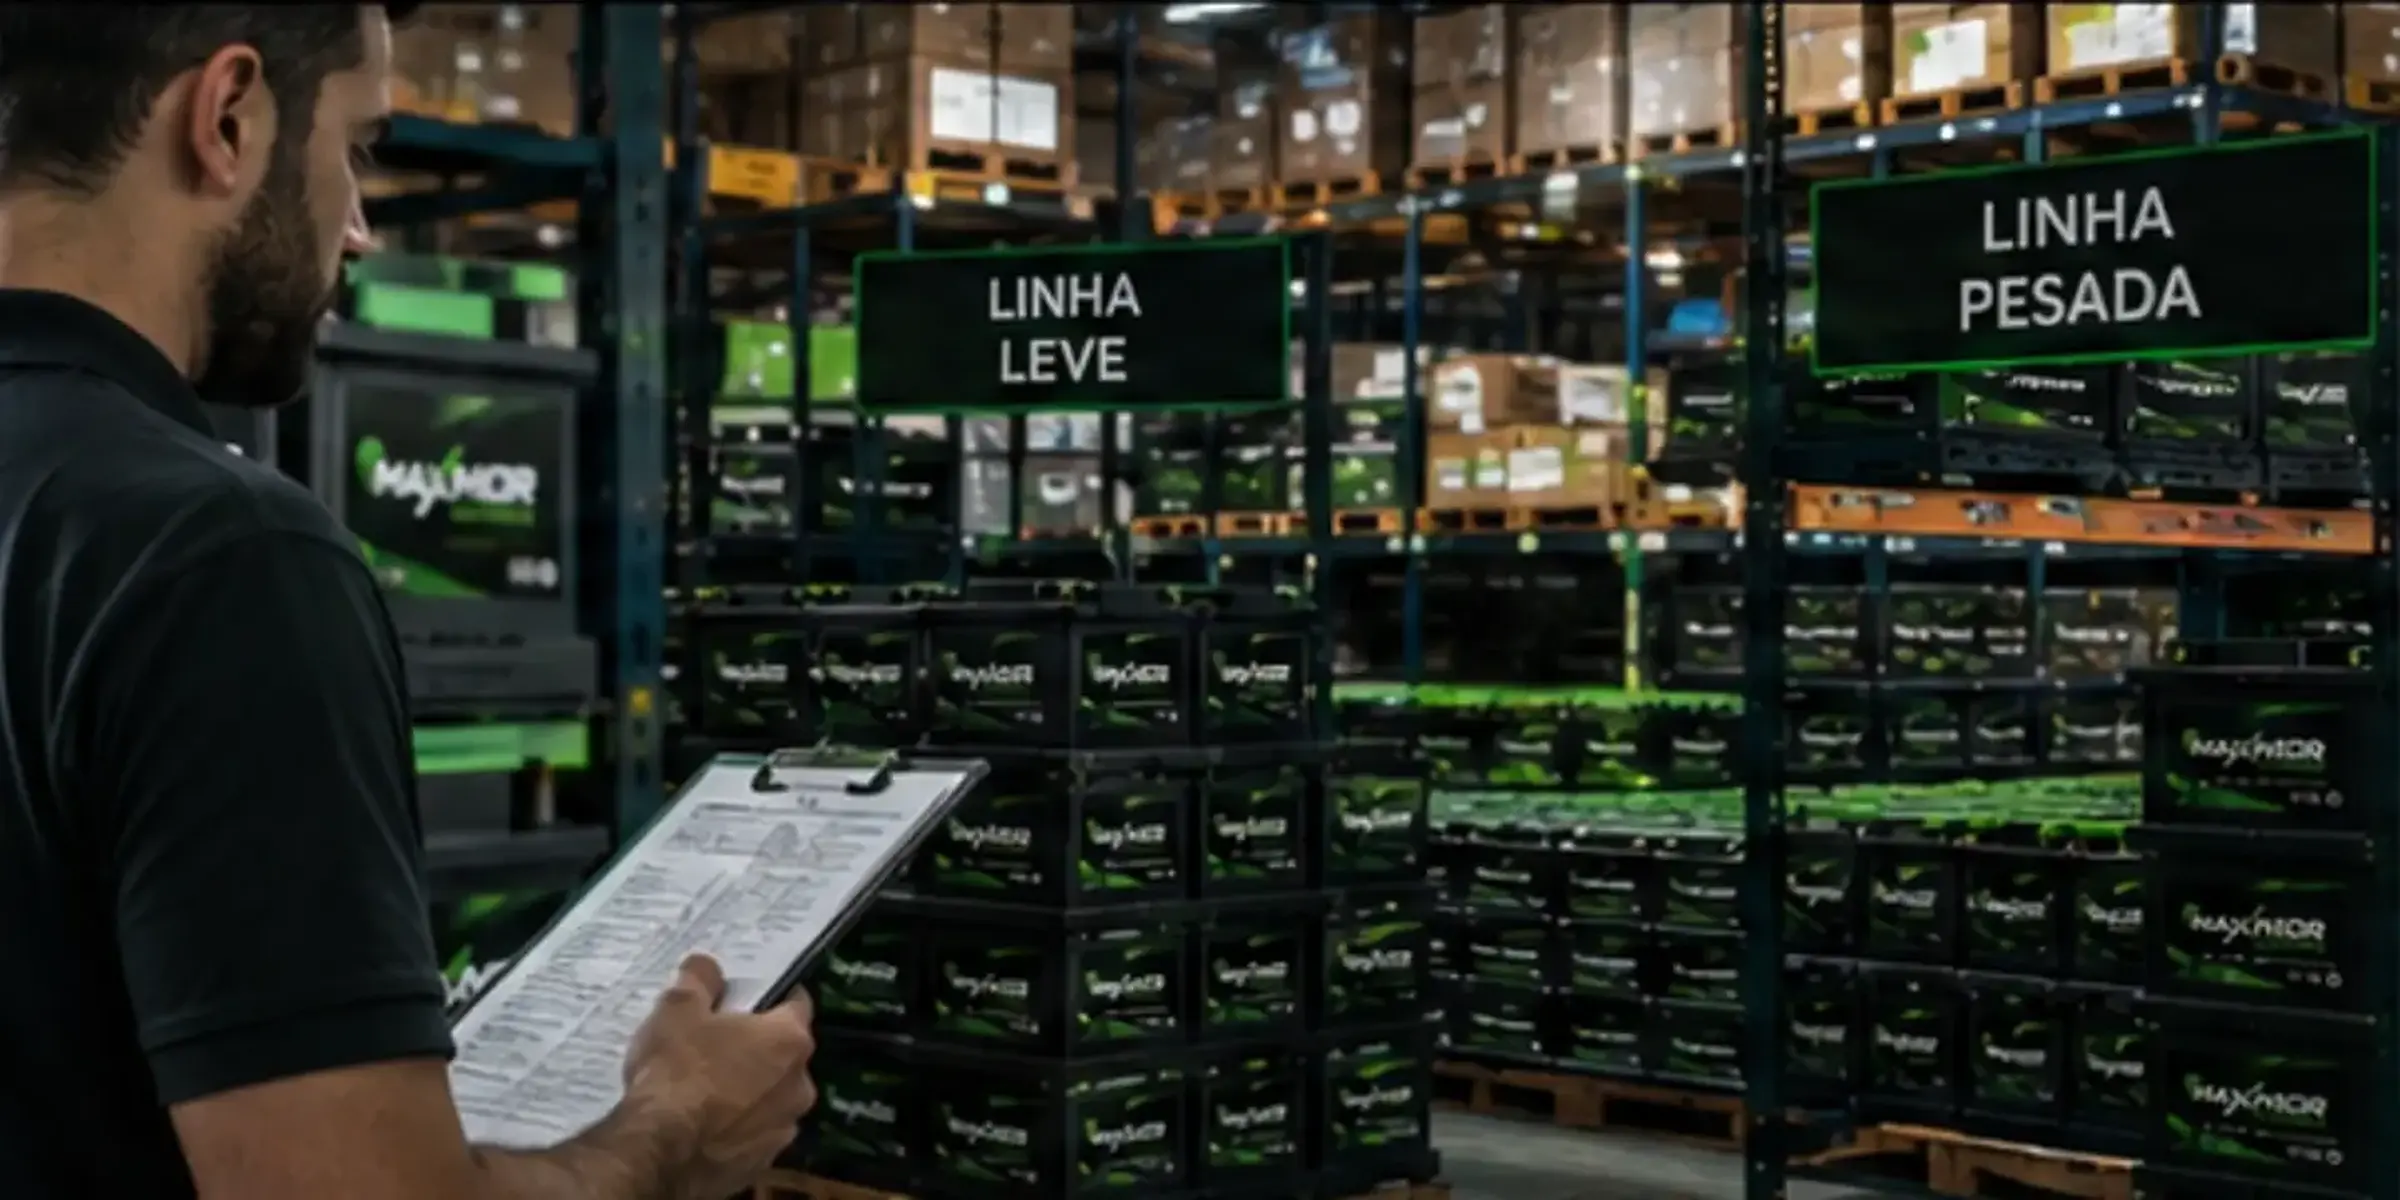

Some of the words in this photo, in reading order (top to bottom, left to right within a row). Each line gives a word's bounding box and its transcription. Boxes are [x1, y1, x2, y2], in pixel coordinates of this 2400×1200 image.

[1981, 185, 2175, 253] LINHA
[988, 271, 1142, 321] LINHA
[1959, 265, 2203, 333] PESADA
[999, 336, 1128, 385] LEVE
